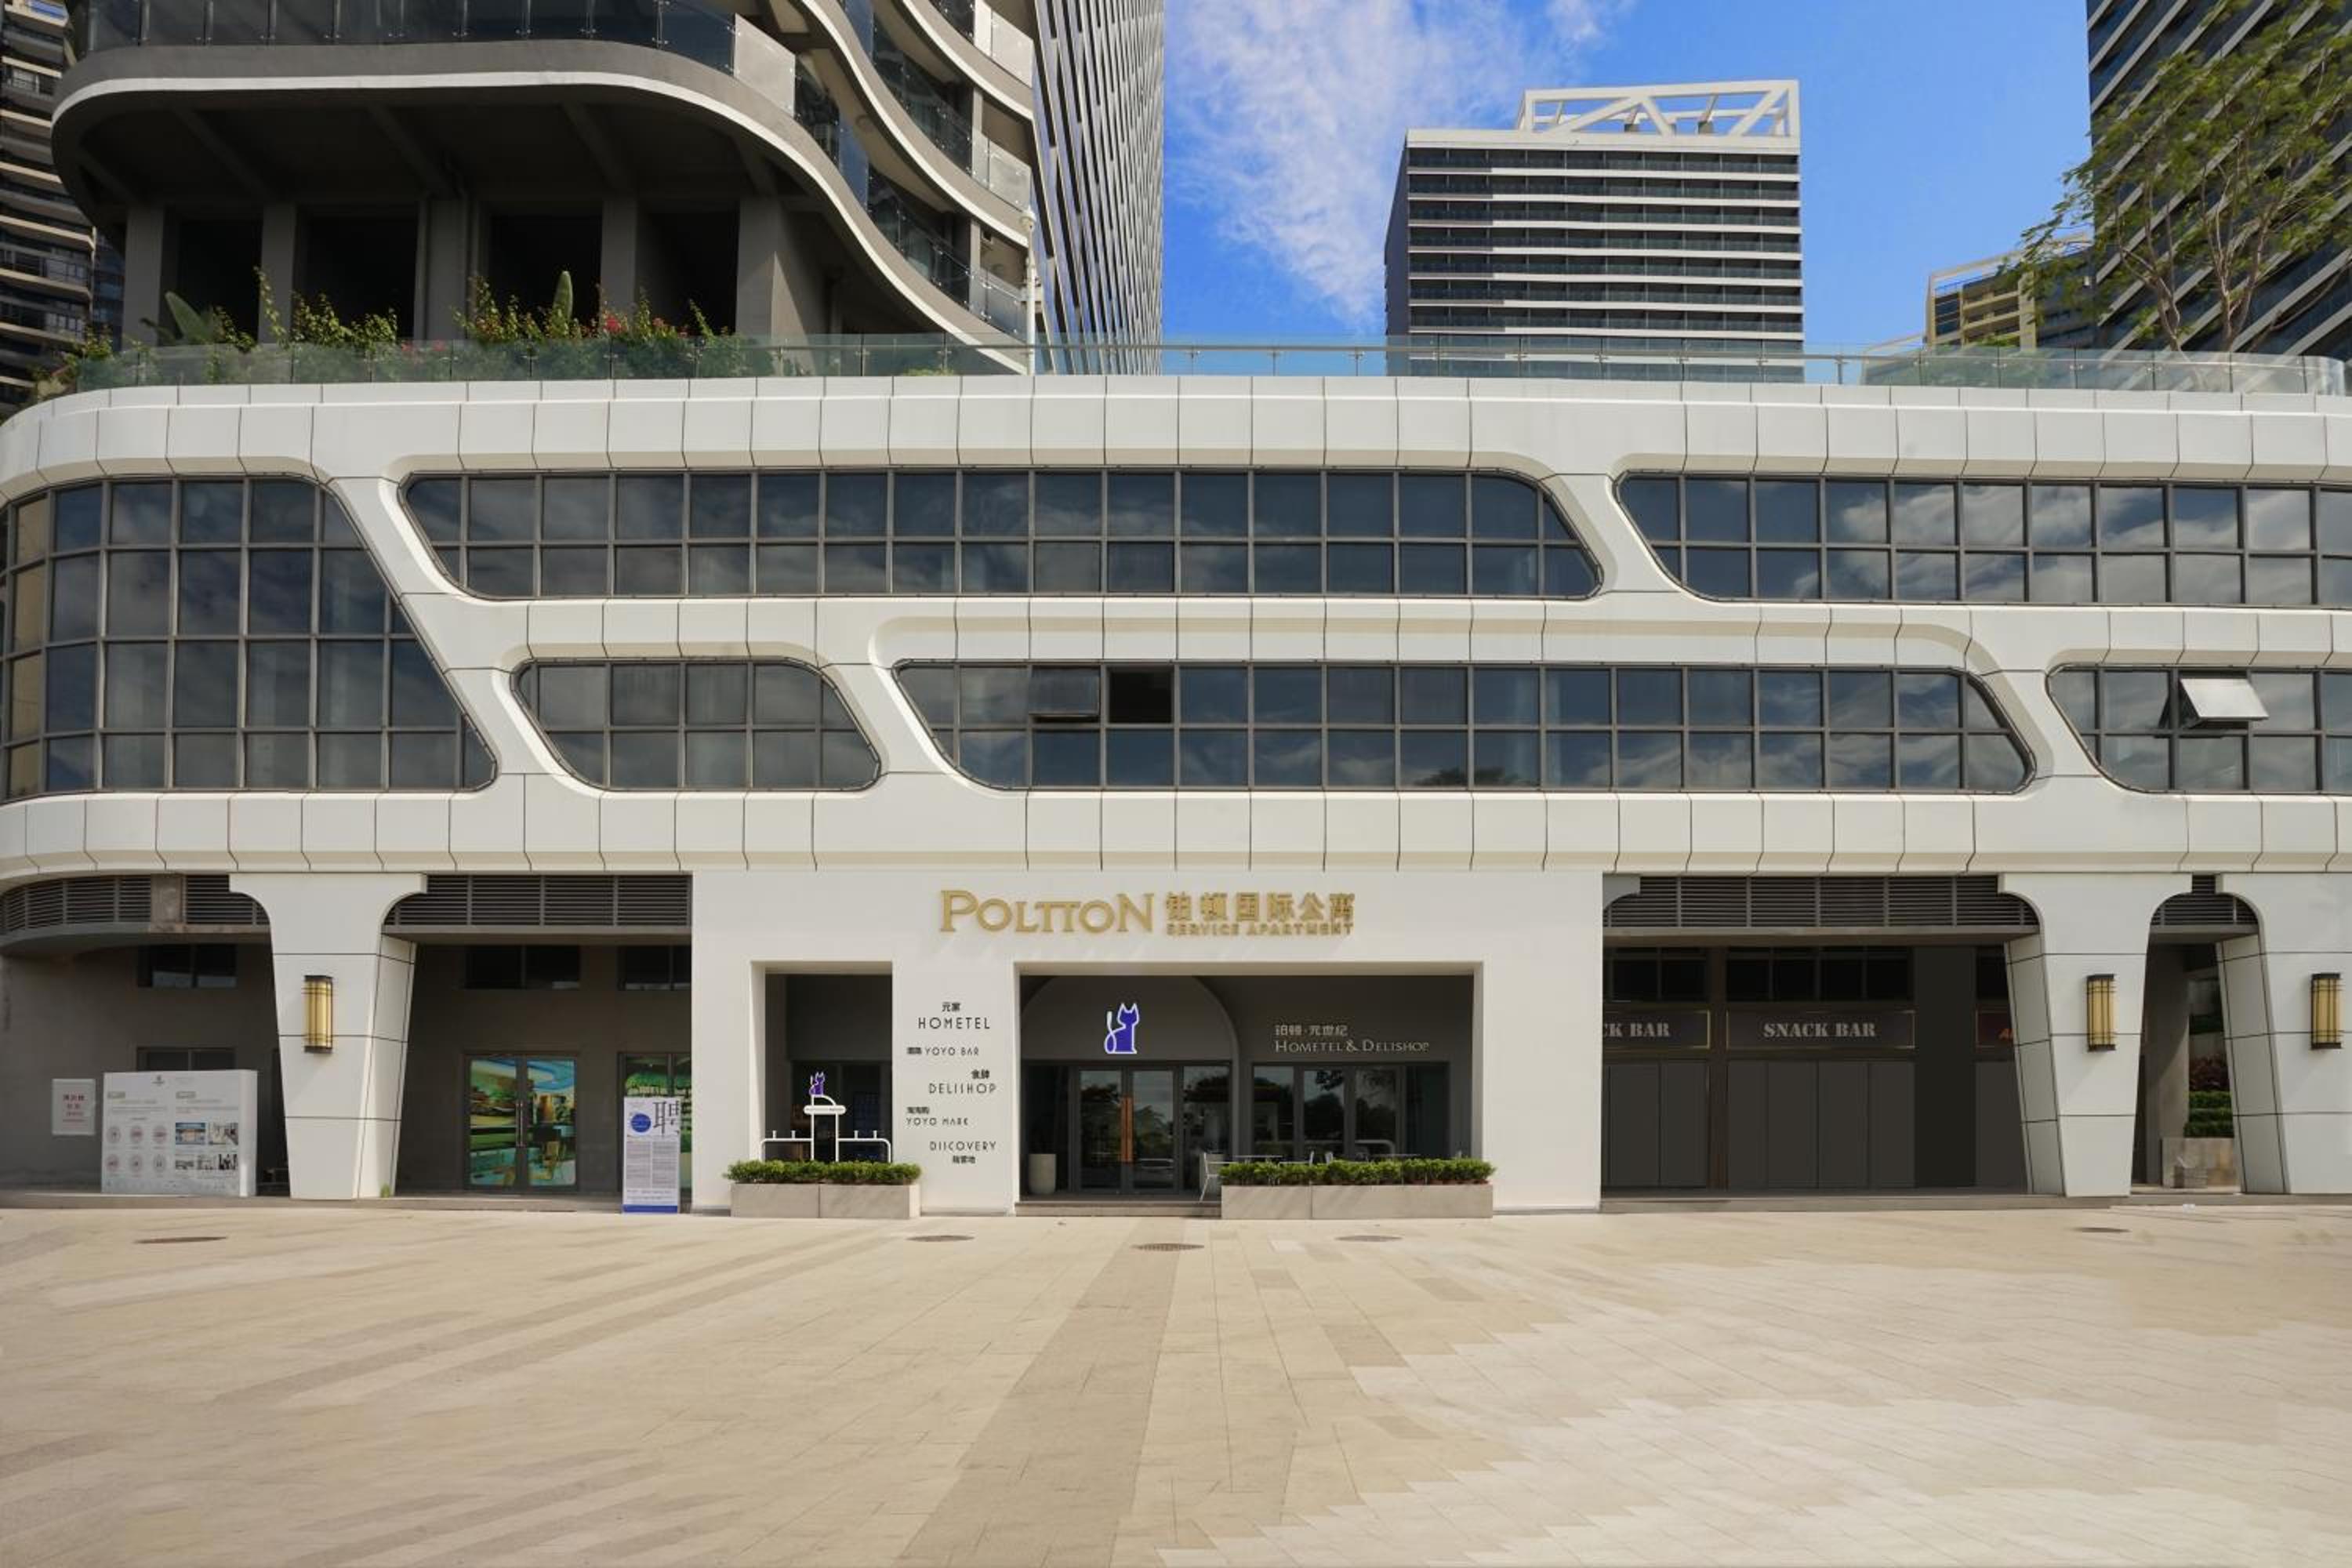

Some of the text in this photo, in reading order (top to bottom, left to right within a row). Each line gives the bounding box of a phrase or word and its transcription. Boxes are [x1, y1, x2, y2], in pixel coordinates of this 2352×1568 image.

[1166, 923, 1354, 936] SERVICE APARTMENT
[917, 1017, 990, 1029] HOMETEL
[1630, 1022, 1670, 1037] BAR
[1764, 1022, 1876, 1037] SNACK BAR
[925, 1047, 956, 1056] YOYO
[960, 1047, 979, 1056] BAR
[1346, 1040, 1359, 1052] &
[906, 1117, 938, 1127] YOYO
